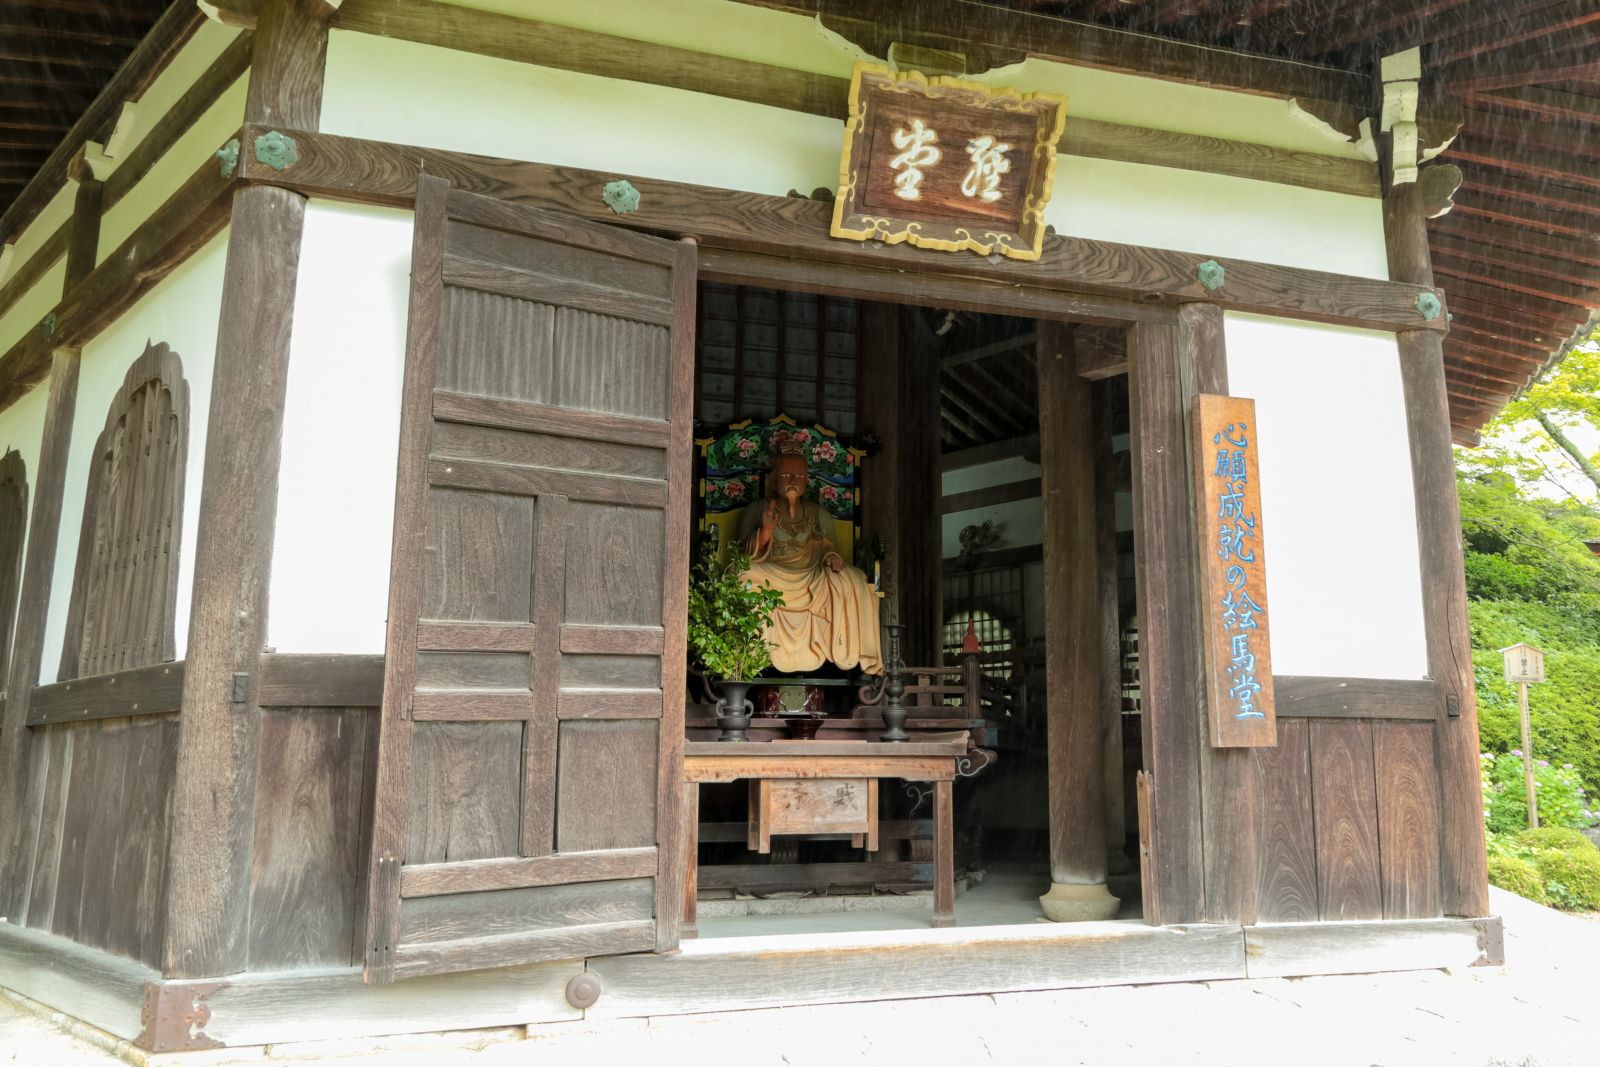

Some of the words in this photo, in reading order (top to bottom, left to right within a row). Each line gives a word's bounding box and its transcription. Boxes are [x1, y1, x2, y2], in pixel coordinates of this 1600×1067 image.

[1213, 422, 1266, 720] 心願成就の絵馬堂
